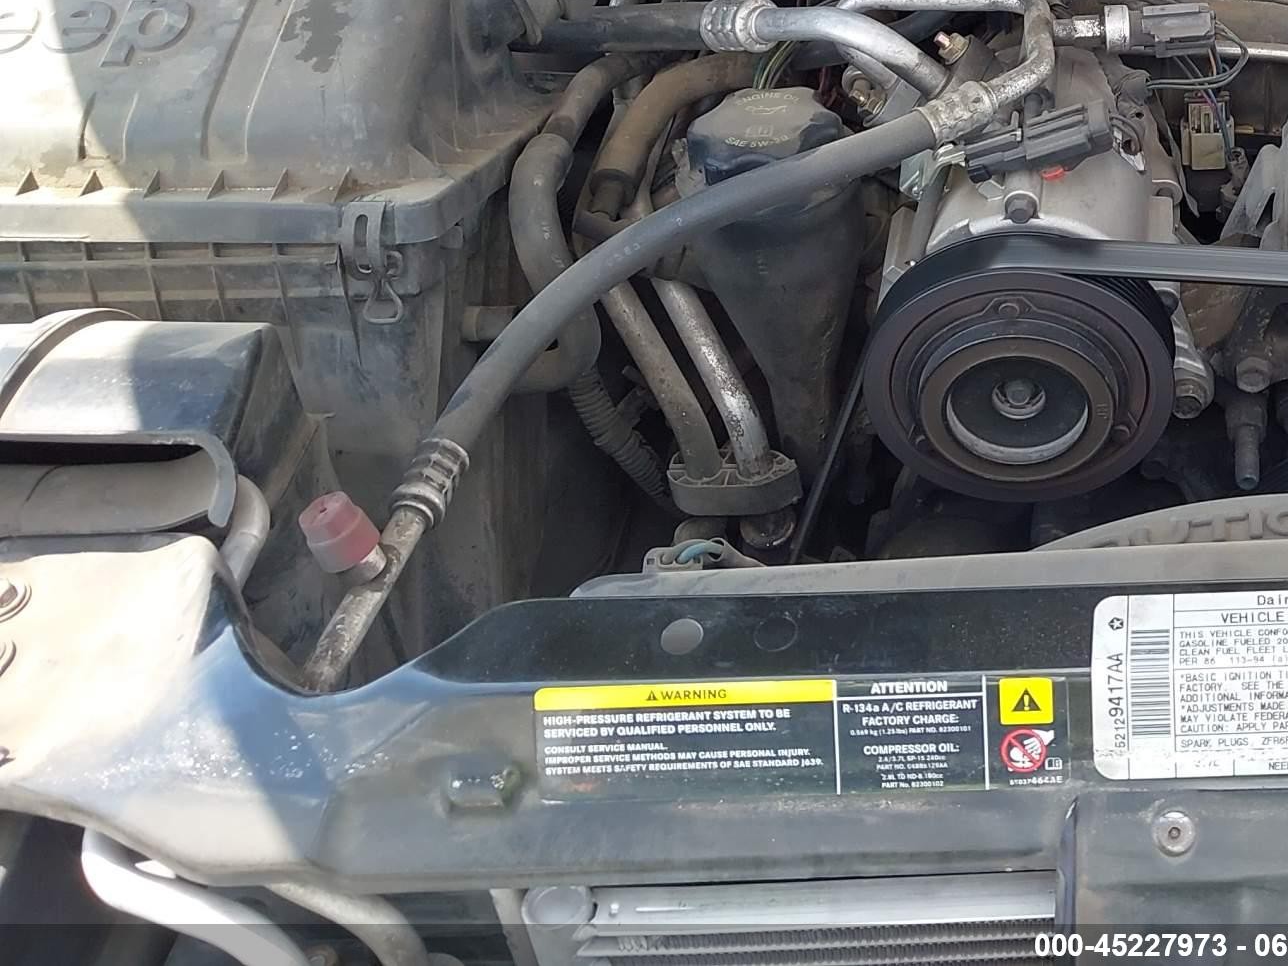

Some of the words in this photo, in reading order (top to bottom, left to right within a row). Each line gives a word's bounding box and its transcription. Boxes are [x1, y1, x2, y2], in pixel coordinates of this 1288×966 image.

[724, 136, 749, 148] SAE
[1221, 611, 1285, 624] VEHICLE
[1179, 630, 1203, 639] THIS
[1210, 629, 1251, 638] VEHICLE
[1224, 671, 1272, 681] IGNITION
[870, 680, 948, 695] ATTENTION
[1179, 682, 1228, 693] FACTORY.
[1241, 681, 1260, 691] SEE
[1266, 680, 1284, 689] THE
[660, 688, 727, 701] WARNING
[1107, 652, 1126, 748] 52129417AA
[1180, 692, 1241, 703] ADDITIONAL
[842, 702, 880, 714] R-134a
[881, 701, 904, 713] A/C
[905, 699, 978, 711] REFRIGERANT
[1260, 700, 1285, 710] MADE
[543, 713, 634, 726] HIGH-PRESSURE
[635, 710, 711, 724] REFRIGERANT
[713, 709, 757, 722] SYSTEM
[759, 709, 773, 719] TO
[775, 708, 791, 718] BE
[862, 715, 911, 727] FACTORY
[912, 713, 960, 725] CHARGE:
[1181, 714, 1199, 724] MAY
[1205, 713, 1247, 723] VIOLATE
[543, 726, 598, 739] SERVICED
[599, 726, 615, 737] BY
[616, 724, 676, 737] QUALIFIED
[677, 722, 744, 734] PERSONNEL
[745, 721, 776, 733] ONLY.
[1180, 723, 1229, 733] CAUTION:
[1236, 722, 1267, 731] APPLY
[544, 745, 586, 755] CONSULT
[588, 744, 625, 753] SERVICE
[627, 742, 668, 752] MANUAL.
[863, 743, 937, 755] COMPRESSOR
[938, 742, 960, 753] OIL:
[545, 755, 591, 765] IMPROPER
[593, 754, 630, 763] SERVICE
[632, 752, 676, 762] METHODS
[677, 751, 697, 761] MAY
[698, 750, 728, 759] CAUSE
[730, 749, 776, 759] PERSONAL
[777, 748, 811, 758] INJURY.
[545, 766, 581, 776] SYSTEM
[582, 765, 612, 774] MEETS
[614, 764, 647, 773] SAFETY
[648, 761, 718, 772] REQUIREMENTS
[719, 760, 732, 769] OF
[733, 759, 751, 769] SAE
[752, 759, 800, 768] STANDARD
